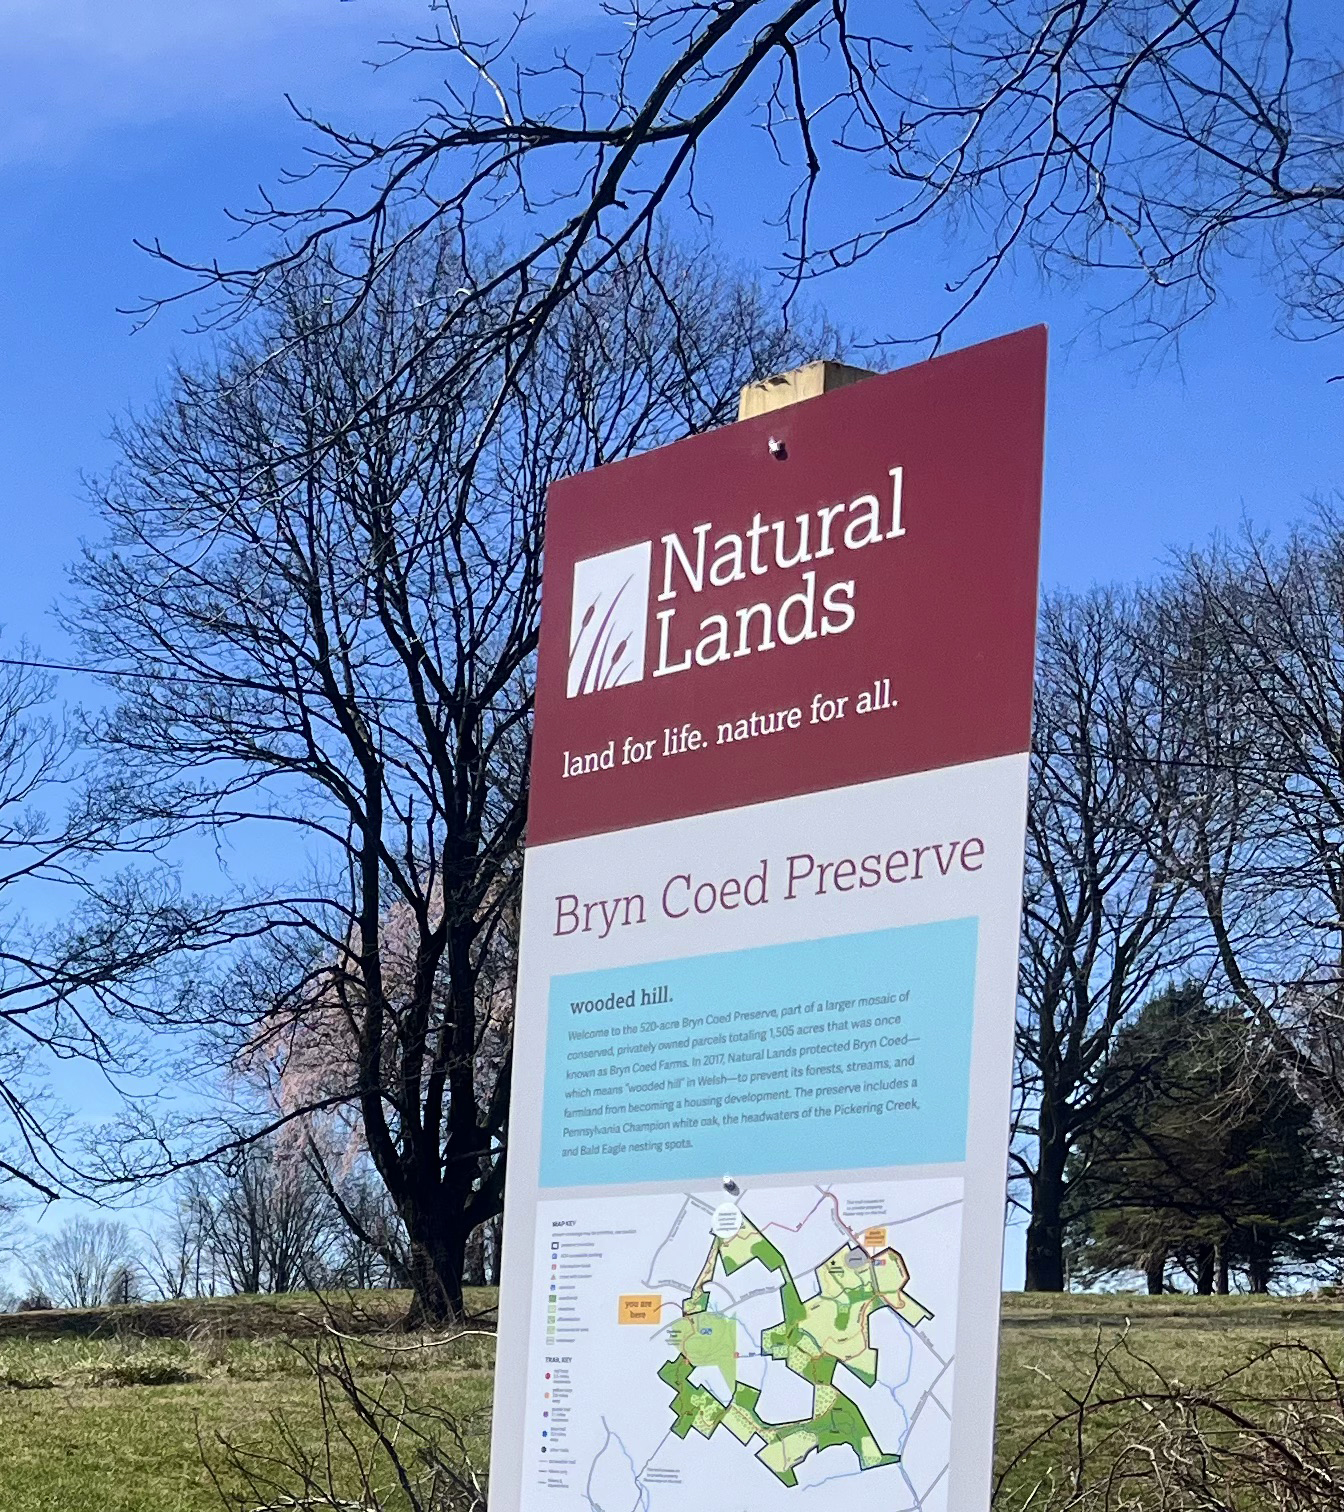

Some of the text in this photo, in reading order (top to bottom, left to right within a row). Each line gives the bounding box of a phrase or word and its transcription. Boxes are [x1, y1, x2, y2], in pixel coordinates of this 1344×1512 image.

[657, 466, 906, 602] Natural
[652, 570, 856, 678] Lands
[562, 679, 898, 778] land for life. nature for all.
[553, 838, 985, 939] Bryn Coed Preserve
[568, 989, 911, 1041] Welcome to the 520-acre Bryn Coed Preserve, part of a larger mosaic of
[570, 985, 673, 1015] wooded hill.
[617, 1041, 657, 1058] privately
[658, 1036, 690, 1051] owned
[691, 1033, 727, 1050] parcels
[729, 1029, 768, 1043] totaling
[769, 1025, 795, 1040] 1,505
[796, 1024, 825, 1036] acres
[827, 1020, 849, 1032] that
[851, 1018, 872, 1030] was
[874, 1015, 901, 1027] once
[565, 1087, 592, 1099] which
[593, 1086, 624, 1096] means
[686, 1077, 696, 1088] in
[750, 1068, 789, 1084] prevent
[791, 1066, 804, 1078] its
[805, 1064, 844, 1076] forests,
[846, 1060, 892, 1072] streams,
[894, 1054, 915, 1068] and
[566, 1069, 596, 1080] known
[597, 1068, 608, 1077] as
[609, 1065, 631, 1078] Bryn
[632, 1060, 657, 1074] Coed
[659, 1059, 690, 1070] Farms.
[692, 1057, 701, 1067] In
[728, 1049, 765, 1063] Natural
[766, 1046, 797, 1060] Lands
[799, 1040, 851, 1059] protected
[853, 1039, 877, 1053] Bryn
[563, 1098, 921, 1138] Pennsylvania Champion white oak, the headwaters of the Pickering Creek,
[564, 1078, 918, 1118] farmland from becoming a housing development. The preserve includes a
[562, 1139, 694, 1158] and Bald Eagle nesting spots.
[624, 1301, 639, 1309] you
